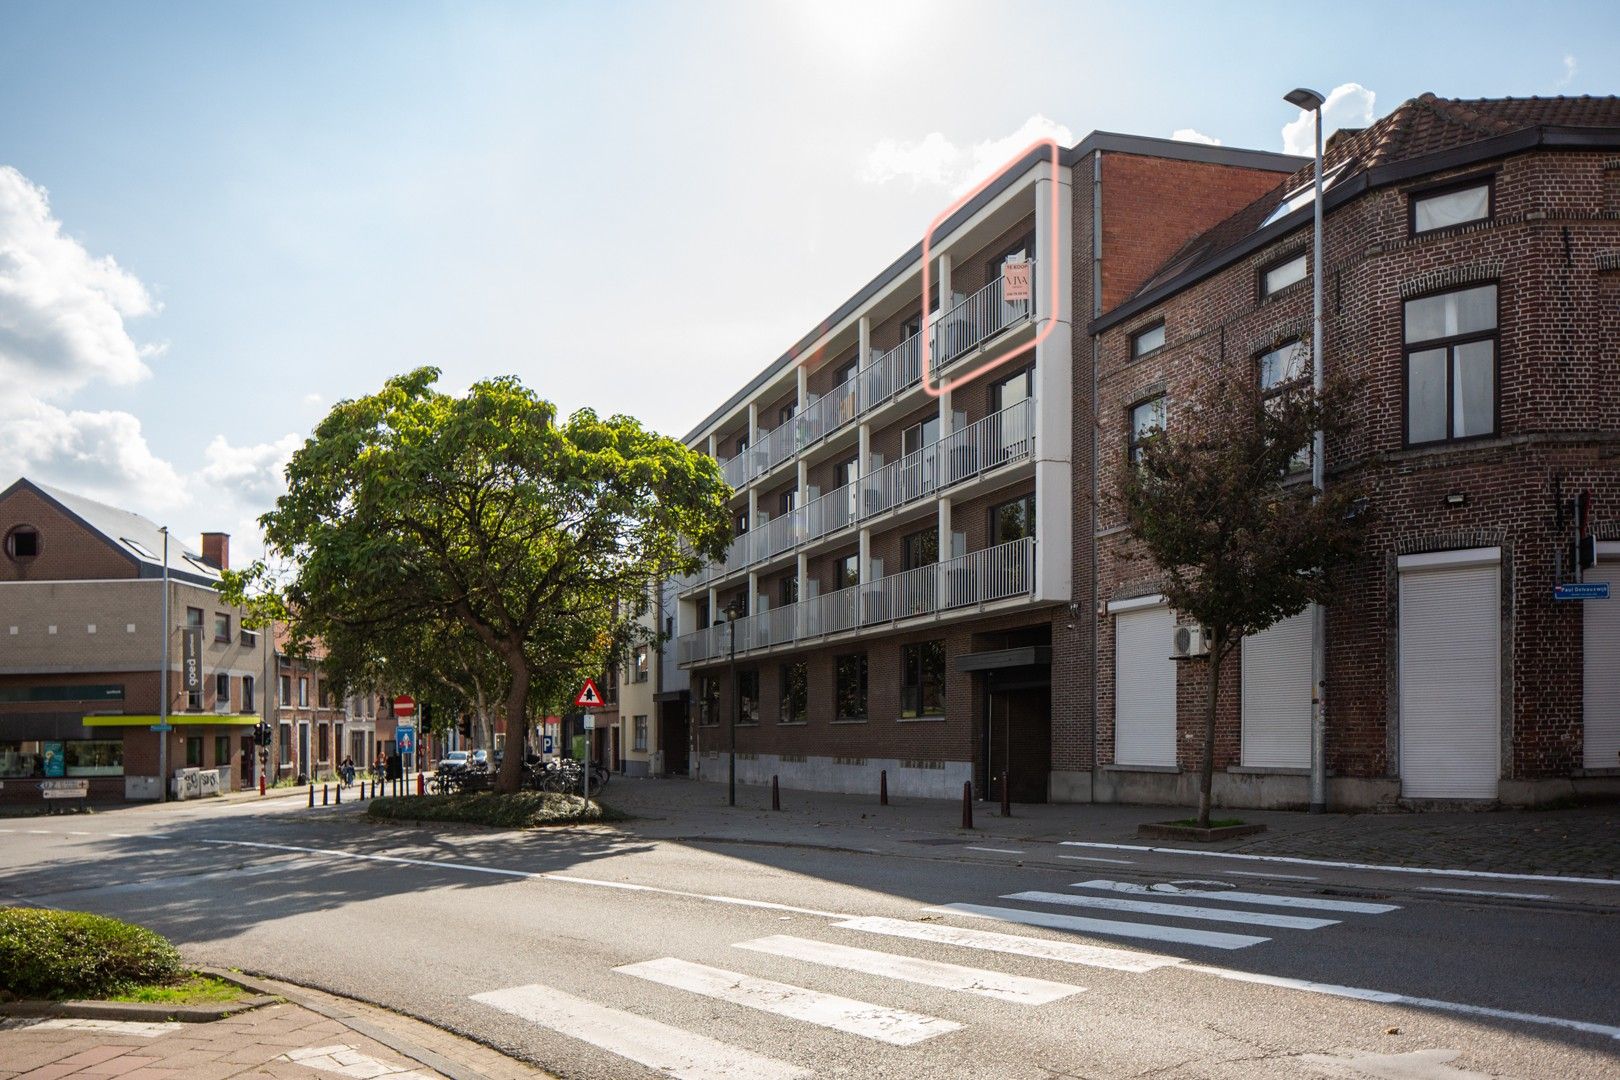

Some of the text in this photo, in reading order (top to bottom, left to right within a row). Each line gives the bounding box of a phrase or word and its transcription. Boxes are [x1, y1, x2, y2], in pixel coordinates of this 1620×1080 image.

[1006, 276, 1028, 285] VIVA
[186, 659, 199, 686] goed
[544, 738, 551, 751] P
